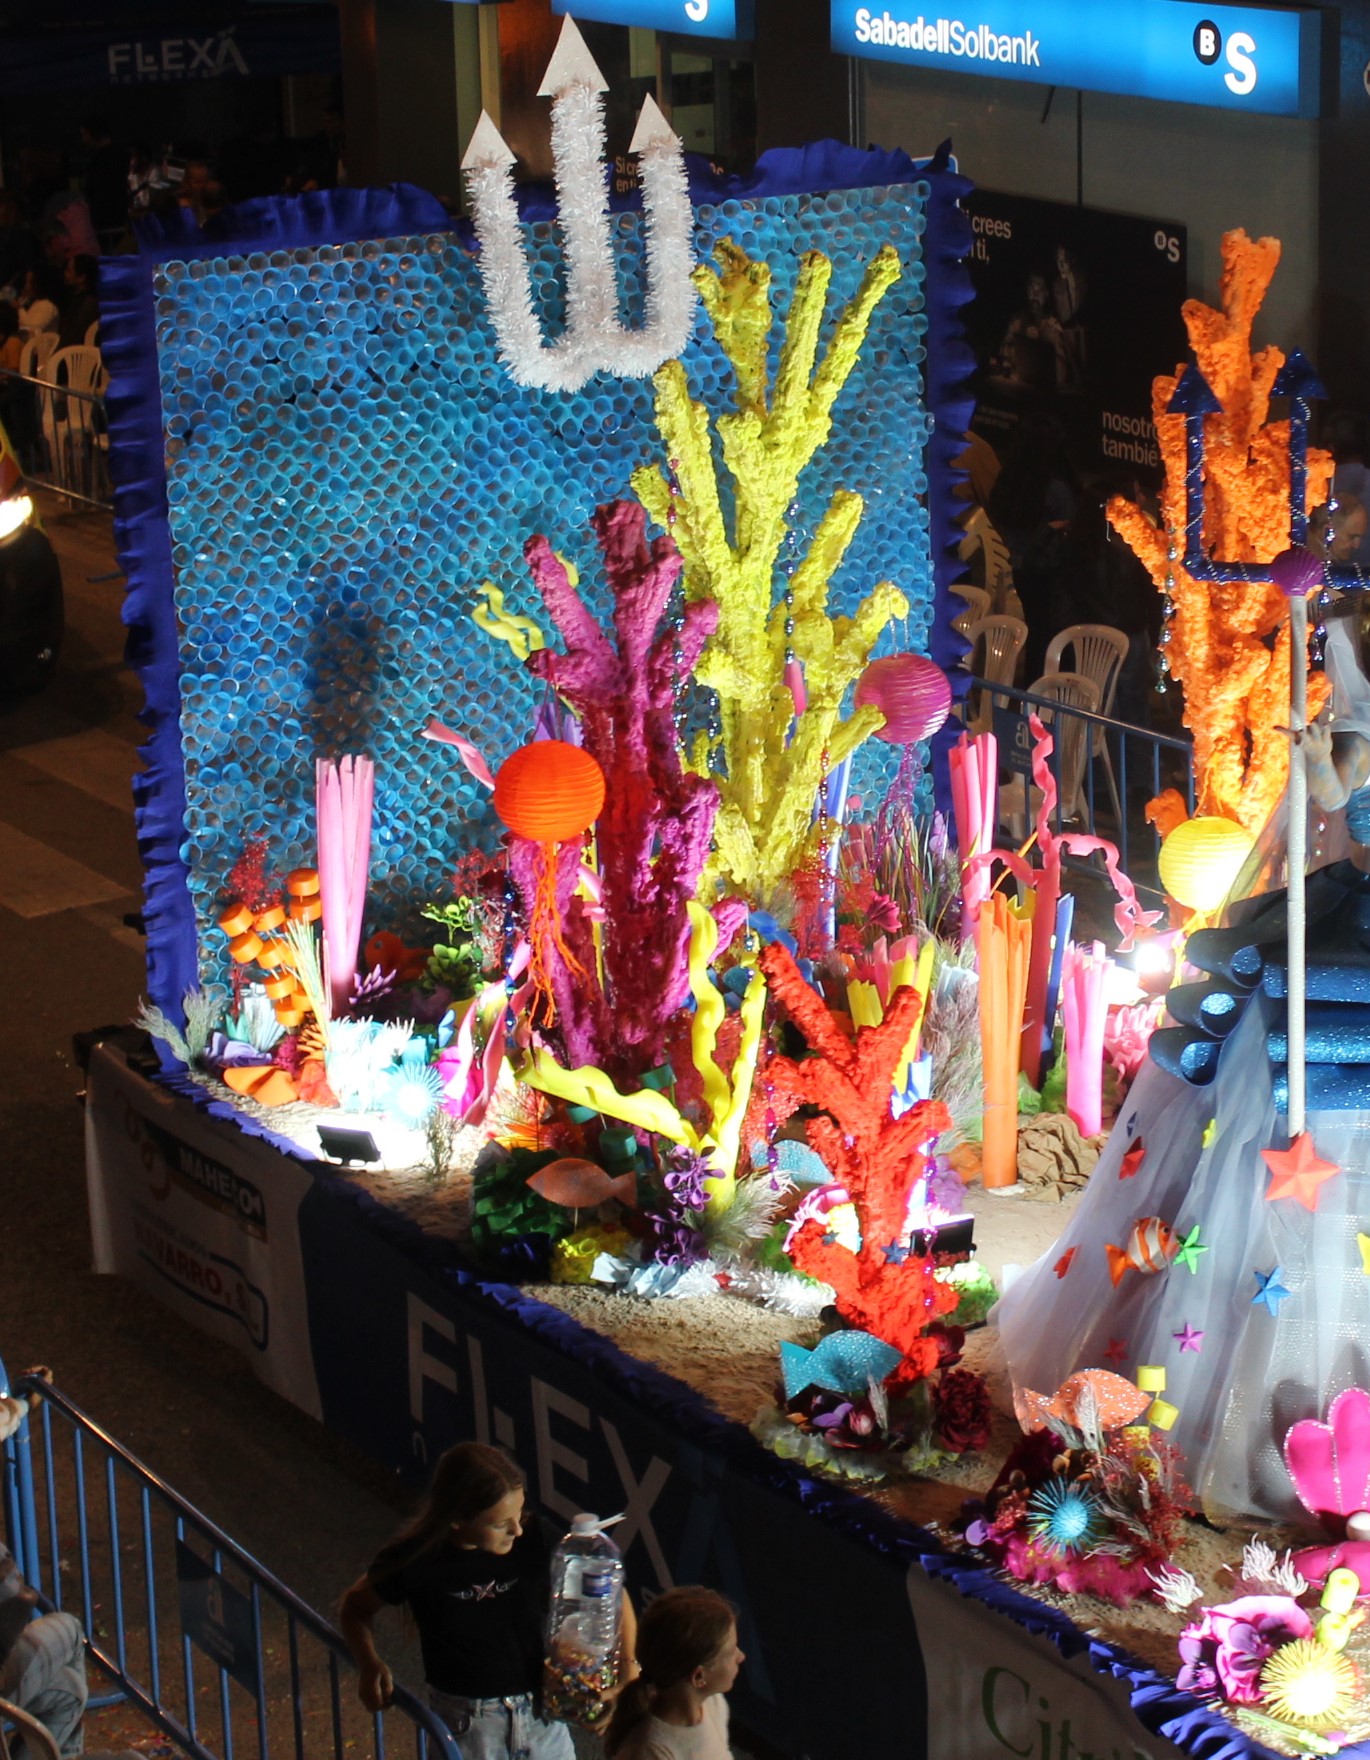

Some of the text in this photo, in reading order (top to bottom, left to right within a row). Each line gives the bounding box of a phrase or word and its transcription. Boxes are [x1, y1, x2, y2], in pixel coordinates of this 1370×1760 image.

[854, 9, 1041, 68] SabadellSolbank
[971, 215, 1012, 240] crees
[1102, 434, 1158, 467] tambié
